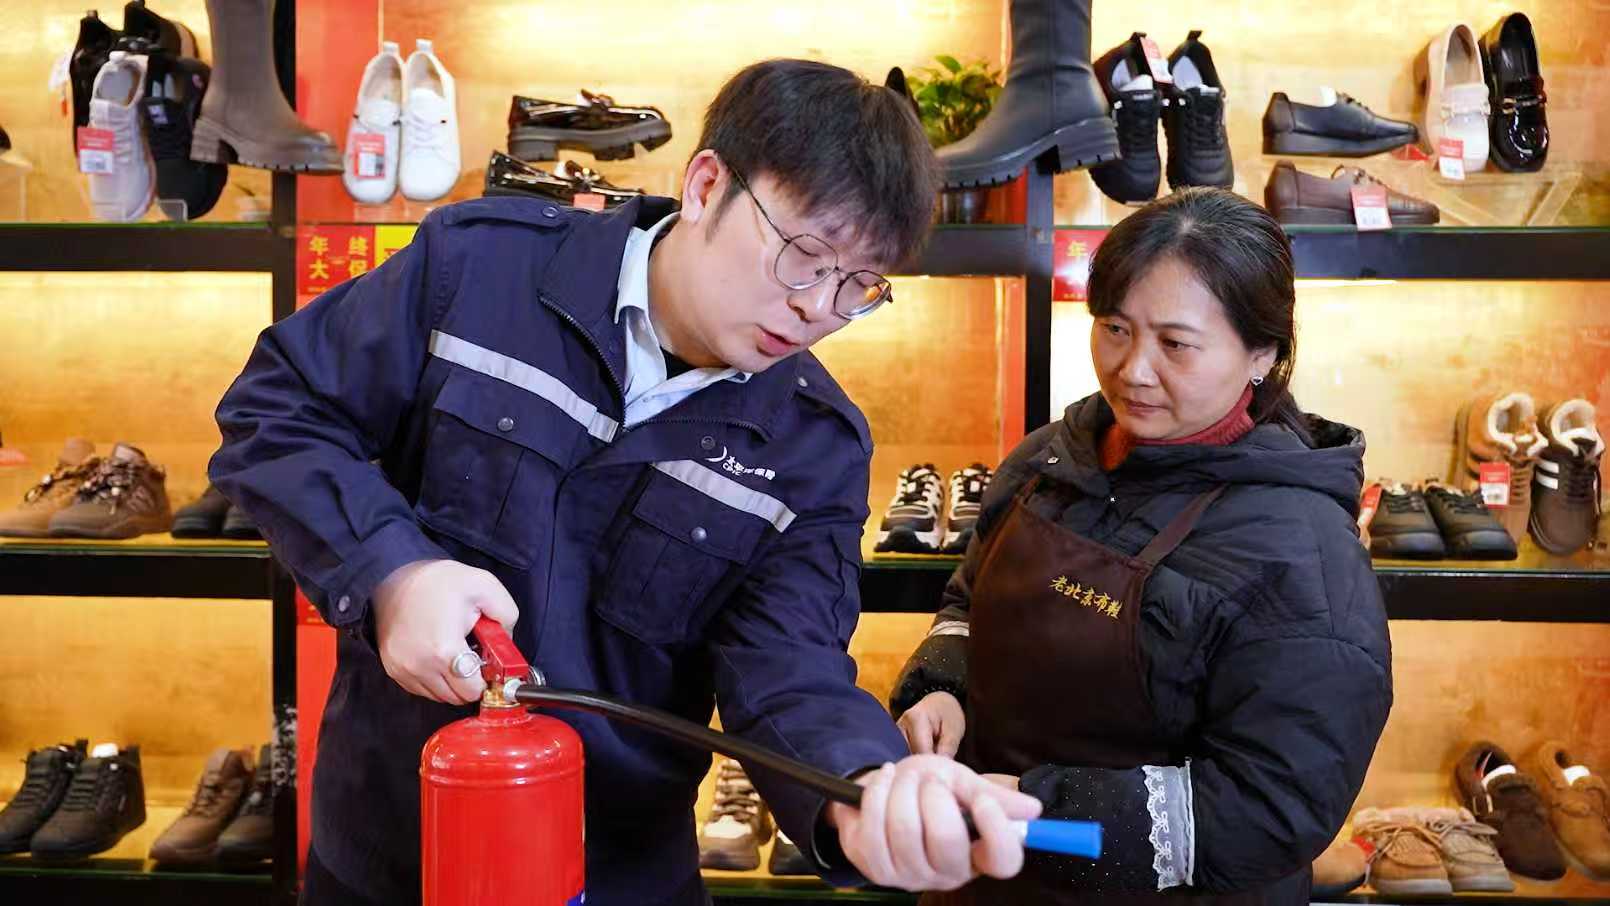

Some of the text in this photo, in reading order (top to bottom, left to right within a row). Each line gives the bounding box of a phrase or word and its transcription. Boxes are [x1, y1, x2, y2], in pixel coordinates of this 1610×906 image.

[1048, 575, 1123, 620] 老北京布鞋
